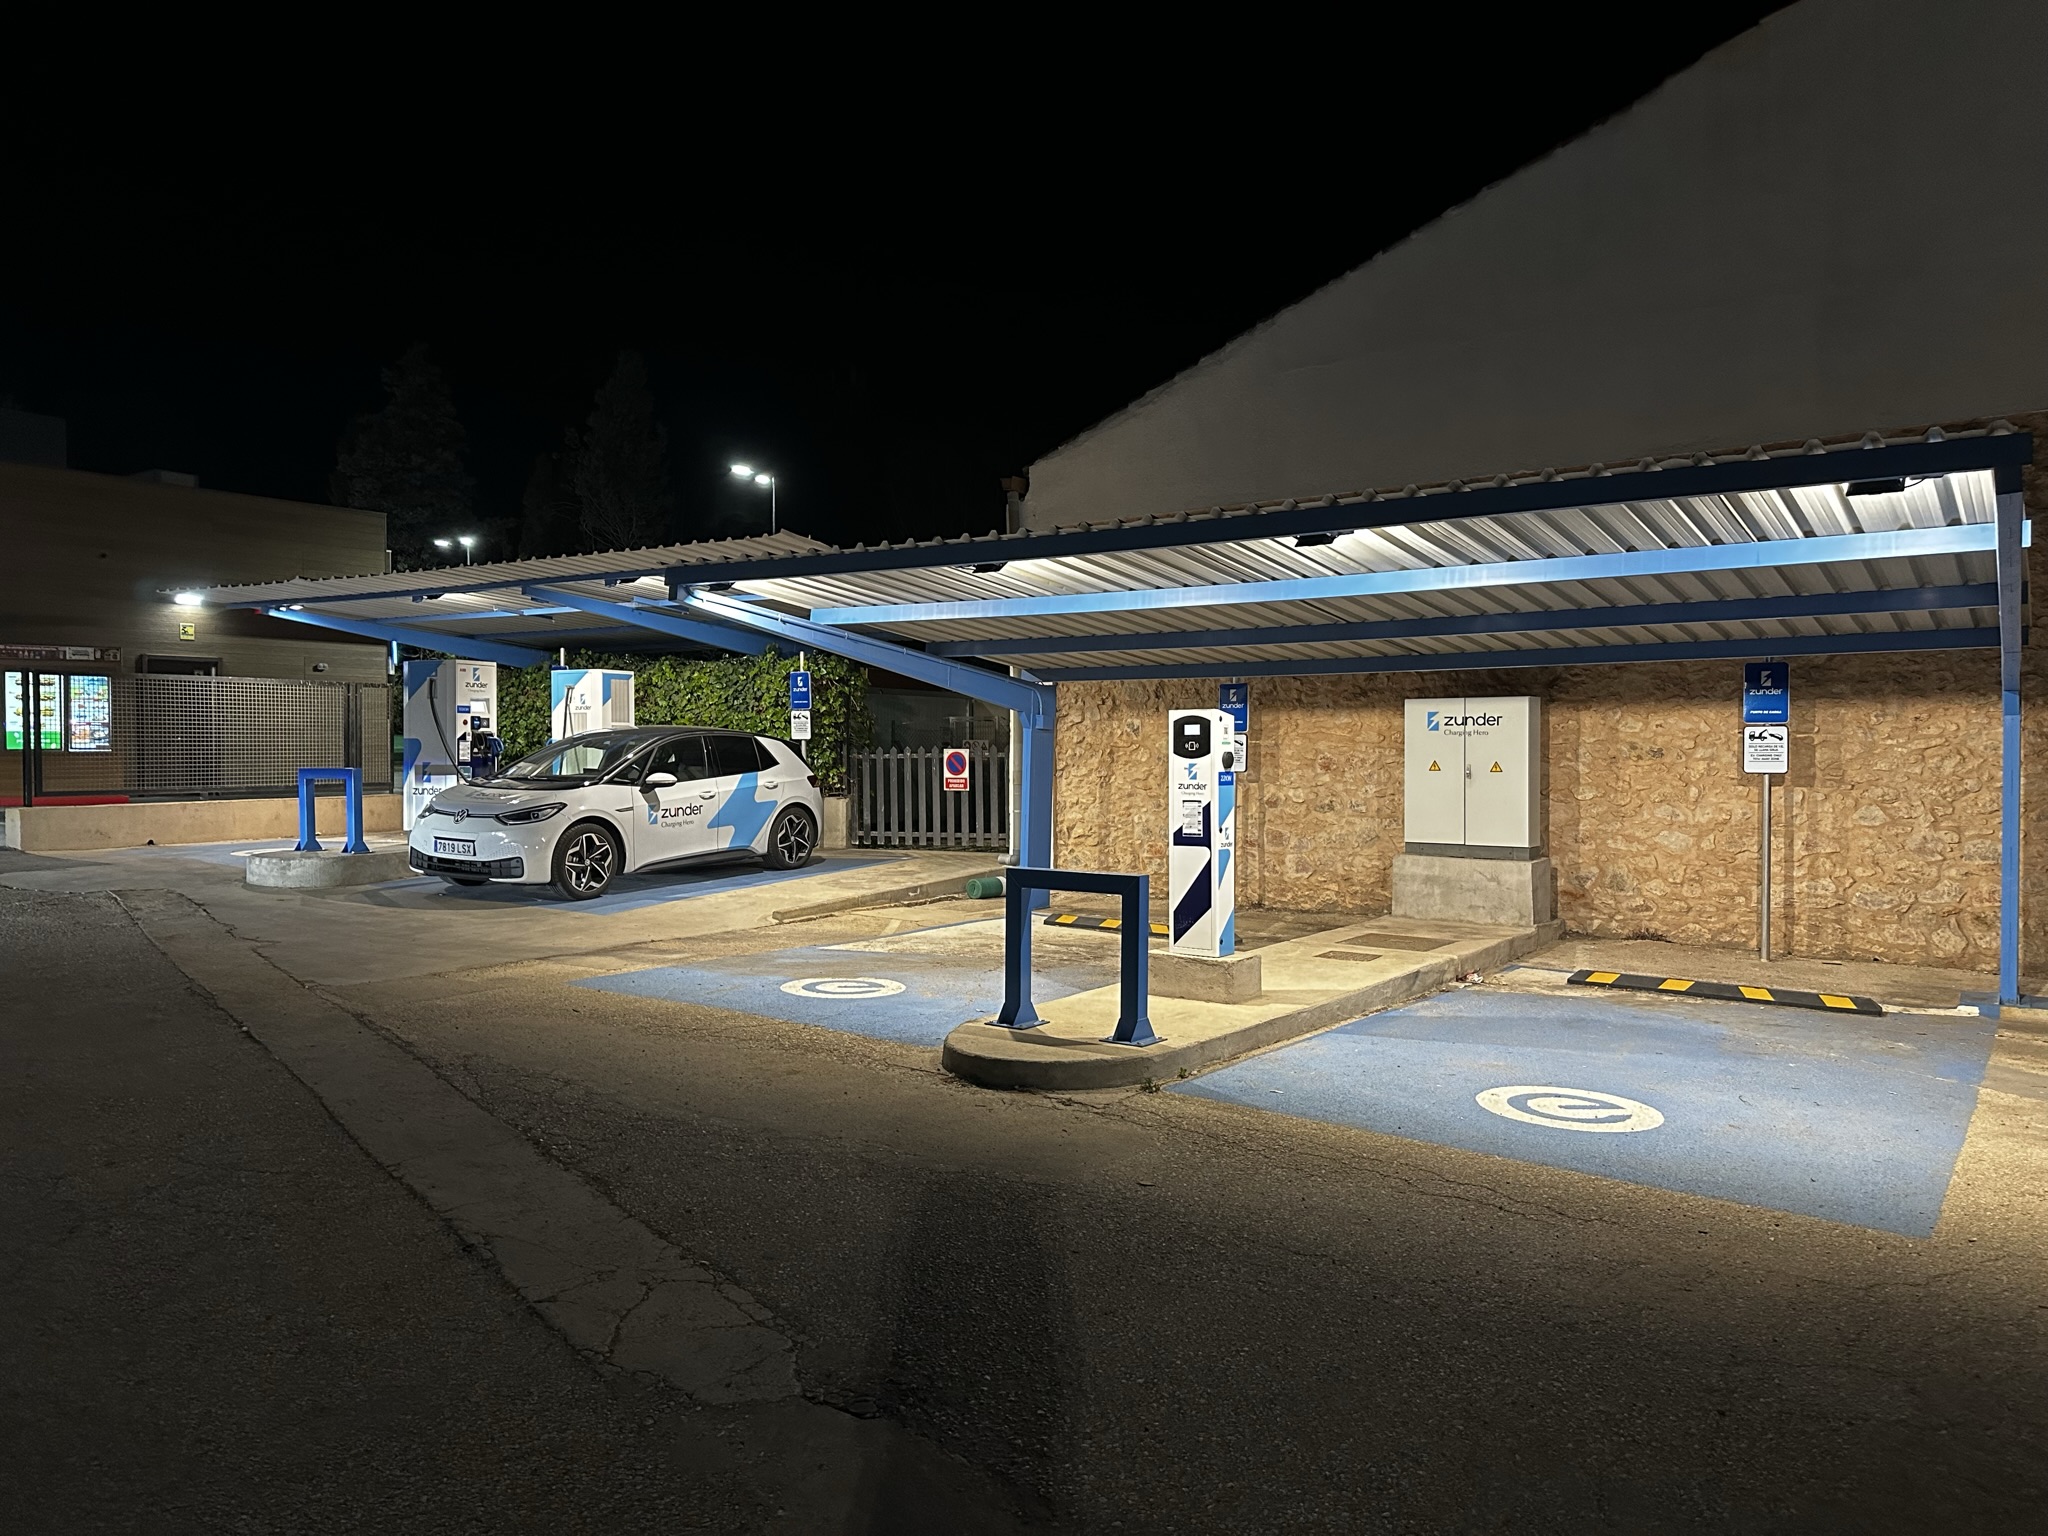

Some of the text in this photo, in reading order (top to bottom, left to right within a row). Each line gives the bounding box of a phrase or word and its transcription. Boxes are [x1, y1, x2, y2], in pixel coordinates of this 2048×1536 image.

[1444, 712, 1503, 726] zunder
[661, 803, 703, 819] zunder
[438, 842, 471, 854] 7819 LSX
